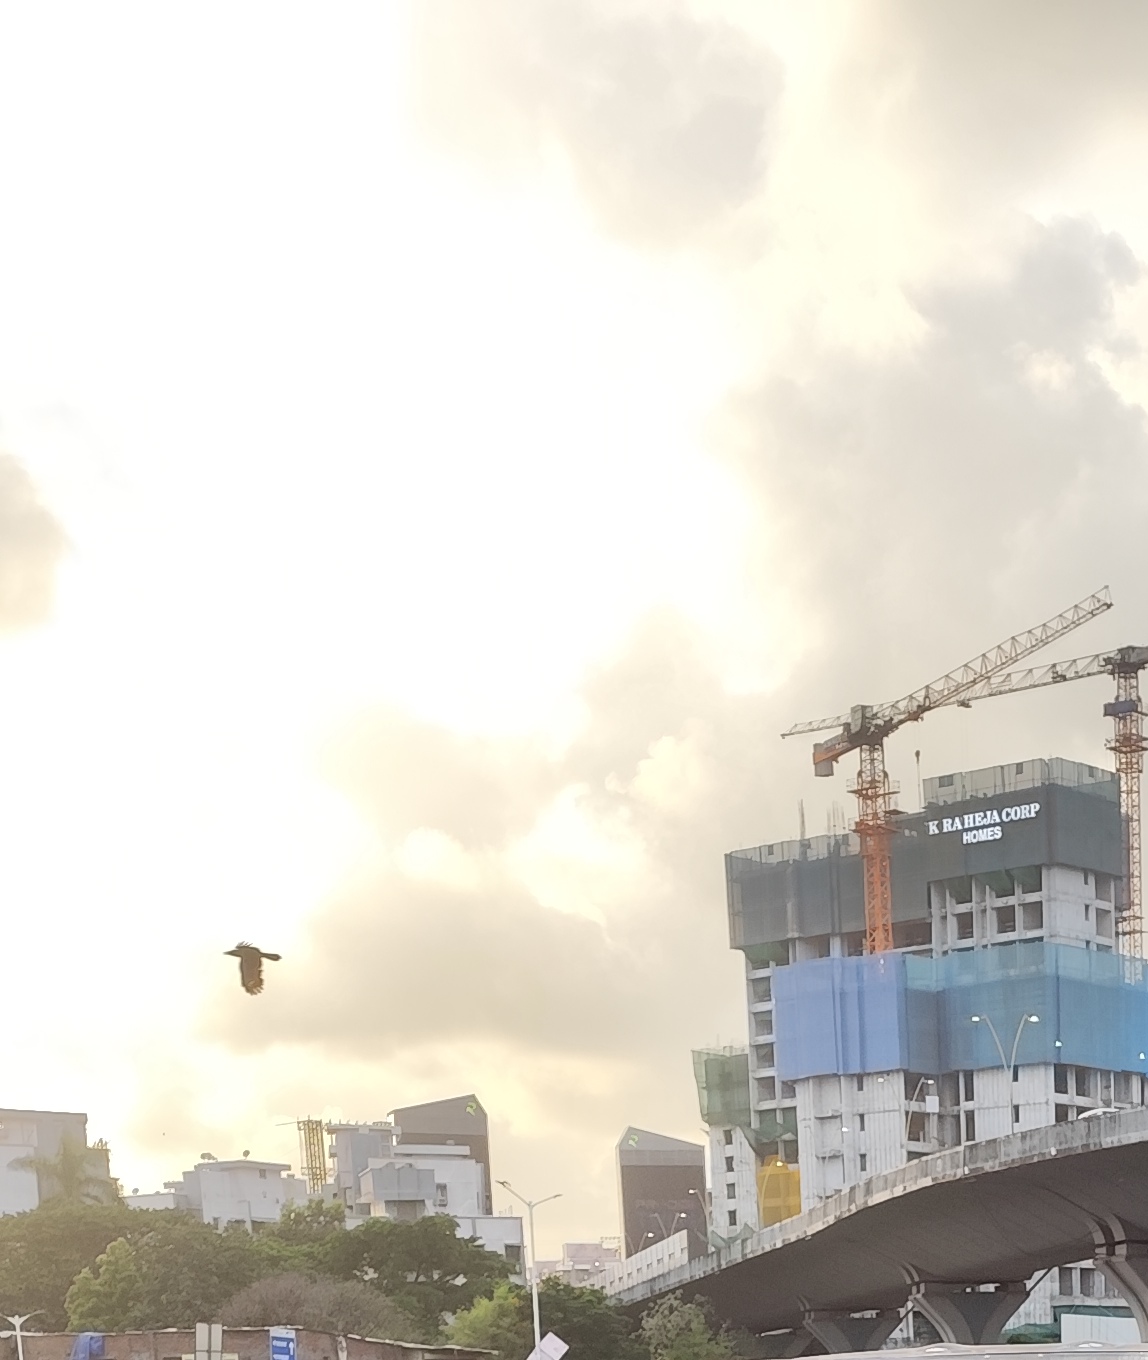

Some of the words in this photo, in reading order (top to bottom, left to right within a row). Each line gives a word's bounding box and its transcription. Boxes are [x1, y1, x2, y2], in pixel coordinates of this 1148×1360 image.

[928, 820, 939, 835] K
[942, 809, 1001, 833] RAHEJA
[1001, 802, 1040, 822] CORP
[962, 825, 1003, 845] HOMES
